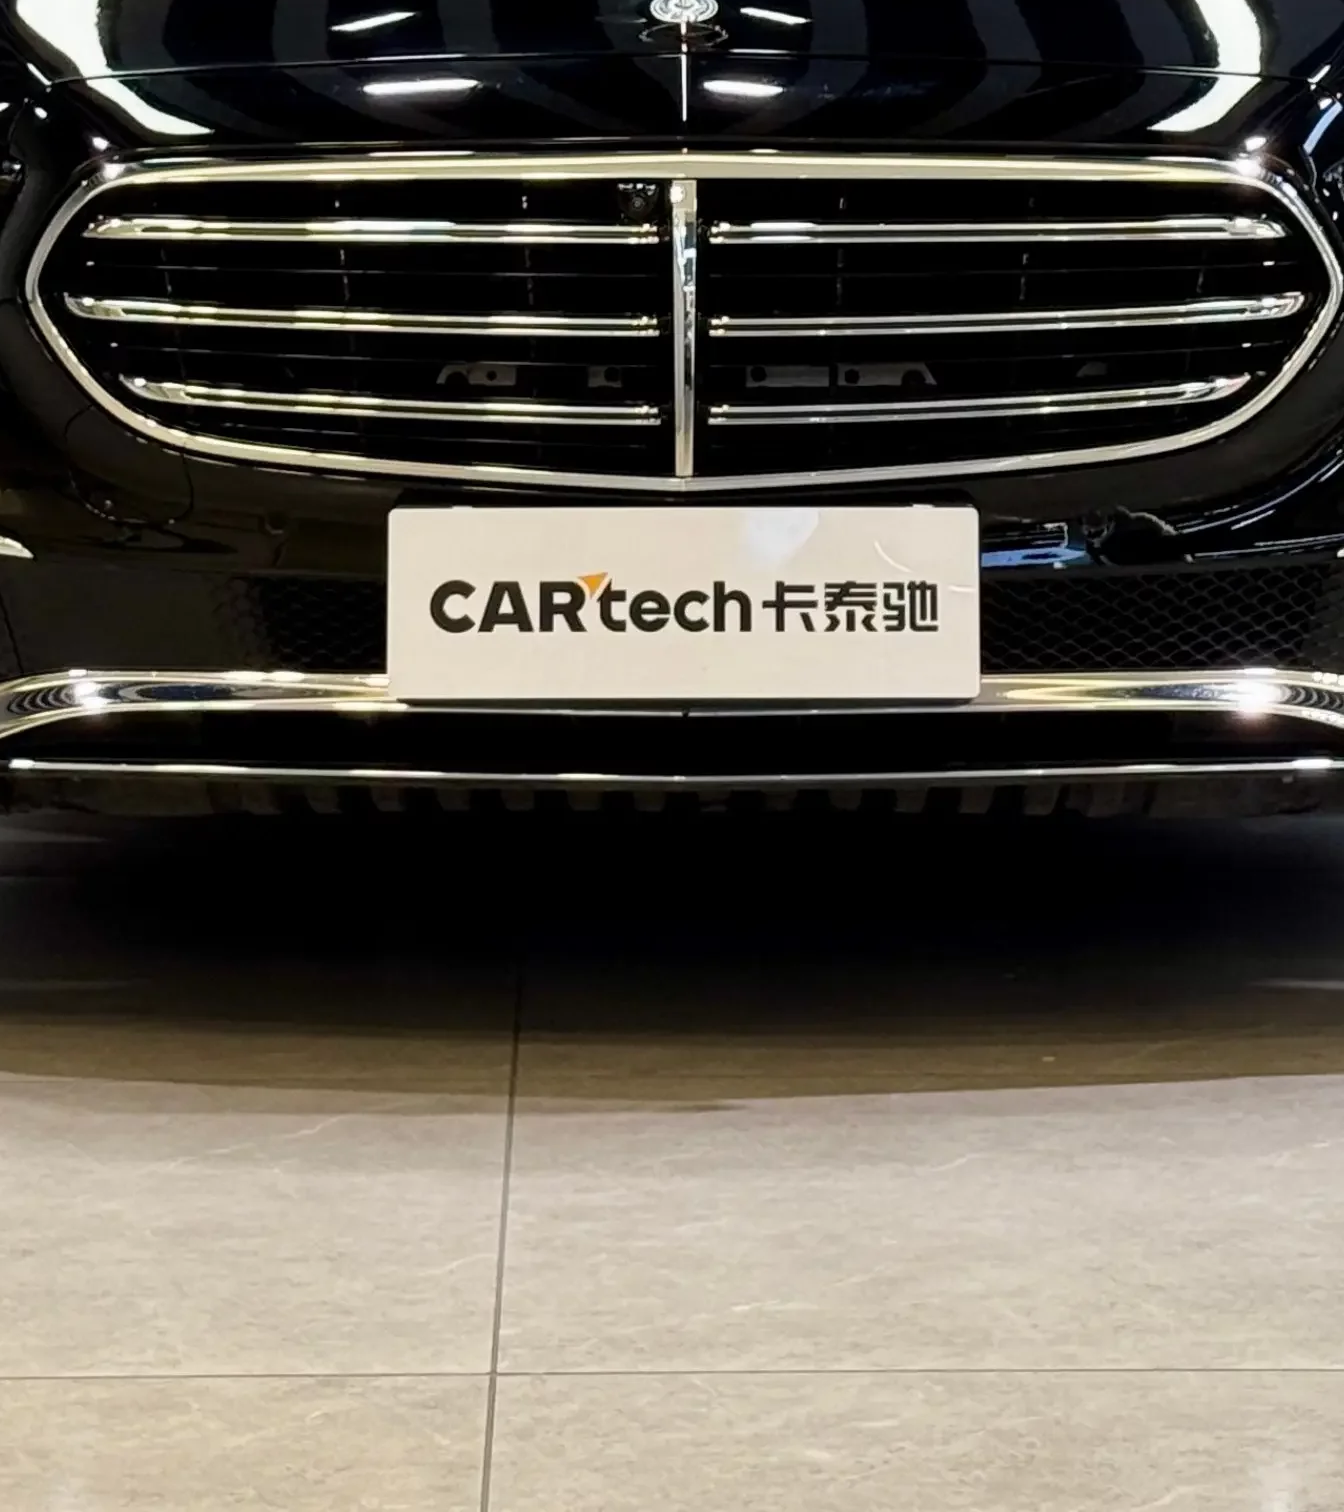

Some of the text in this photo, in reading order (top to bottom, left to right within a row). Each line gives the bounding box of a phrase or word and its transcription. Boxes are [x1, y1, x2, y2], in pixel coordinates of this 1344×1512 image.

[429, 580, 939, 633] CARtech 卡泰驰
